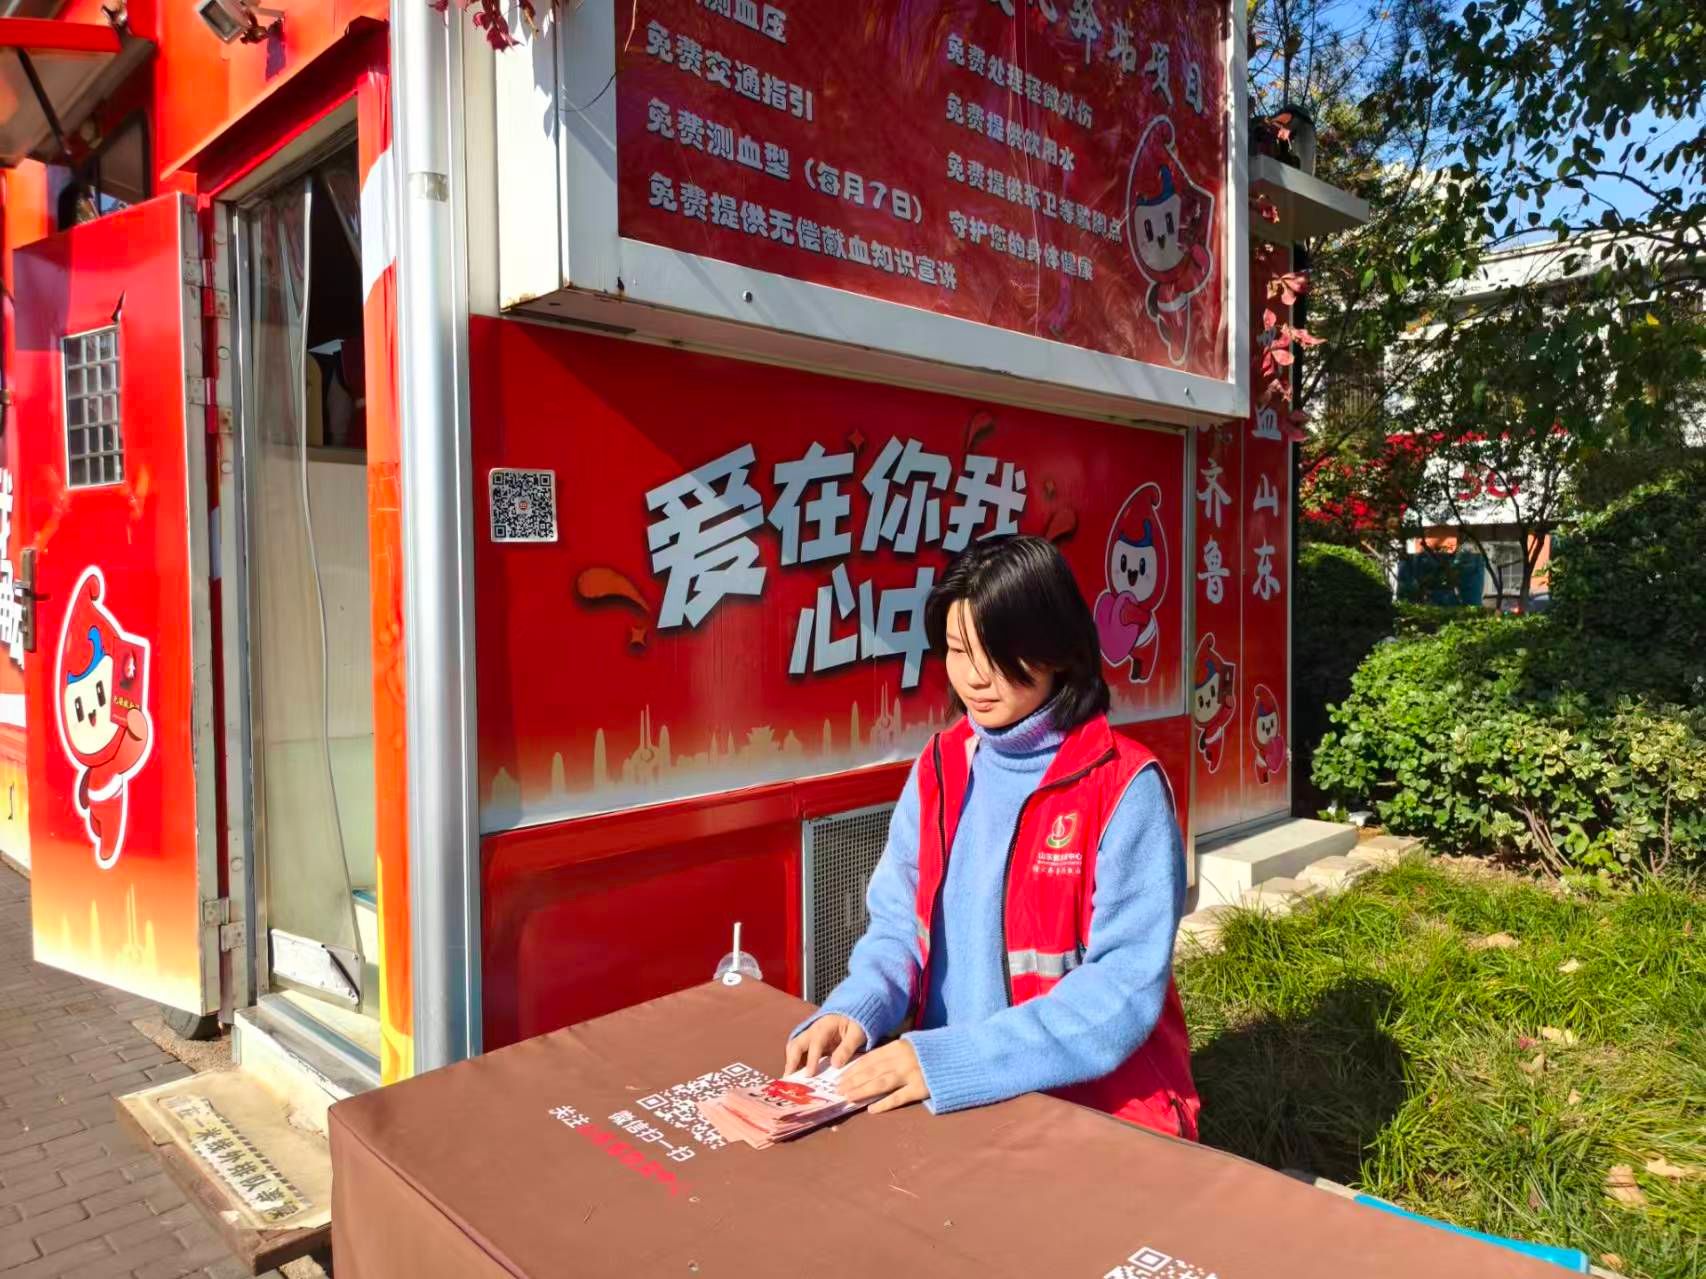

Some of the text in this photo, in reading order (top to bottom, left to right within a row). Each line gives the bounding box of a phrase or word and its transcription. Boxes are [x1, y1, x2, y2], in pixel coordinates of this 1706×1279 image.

[646, 19, 814, 122] 免费交通指引
[946, 32, 1093, 130] 免费处理轻微外伤
[945, 91, 1075, 172] 免费提供饮用水
[648, 171, 958, 290] 免费提供无偿献血知识宣讲
[948, 209, 1094, 281] 守护您的身体健康
[645, 434, 1028, 629] 爱在你我
[788, 562, 936, 689] 心中
[168, 1098, 300, 1221] 在一米线外排队等候
[547, 1104, 591, 1129] 关注
[607, 1109, 696, 1162] 微信扫一扫
